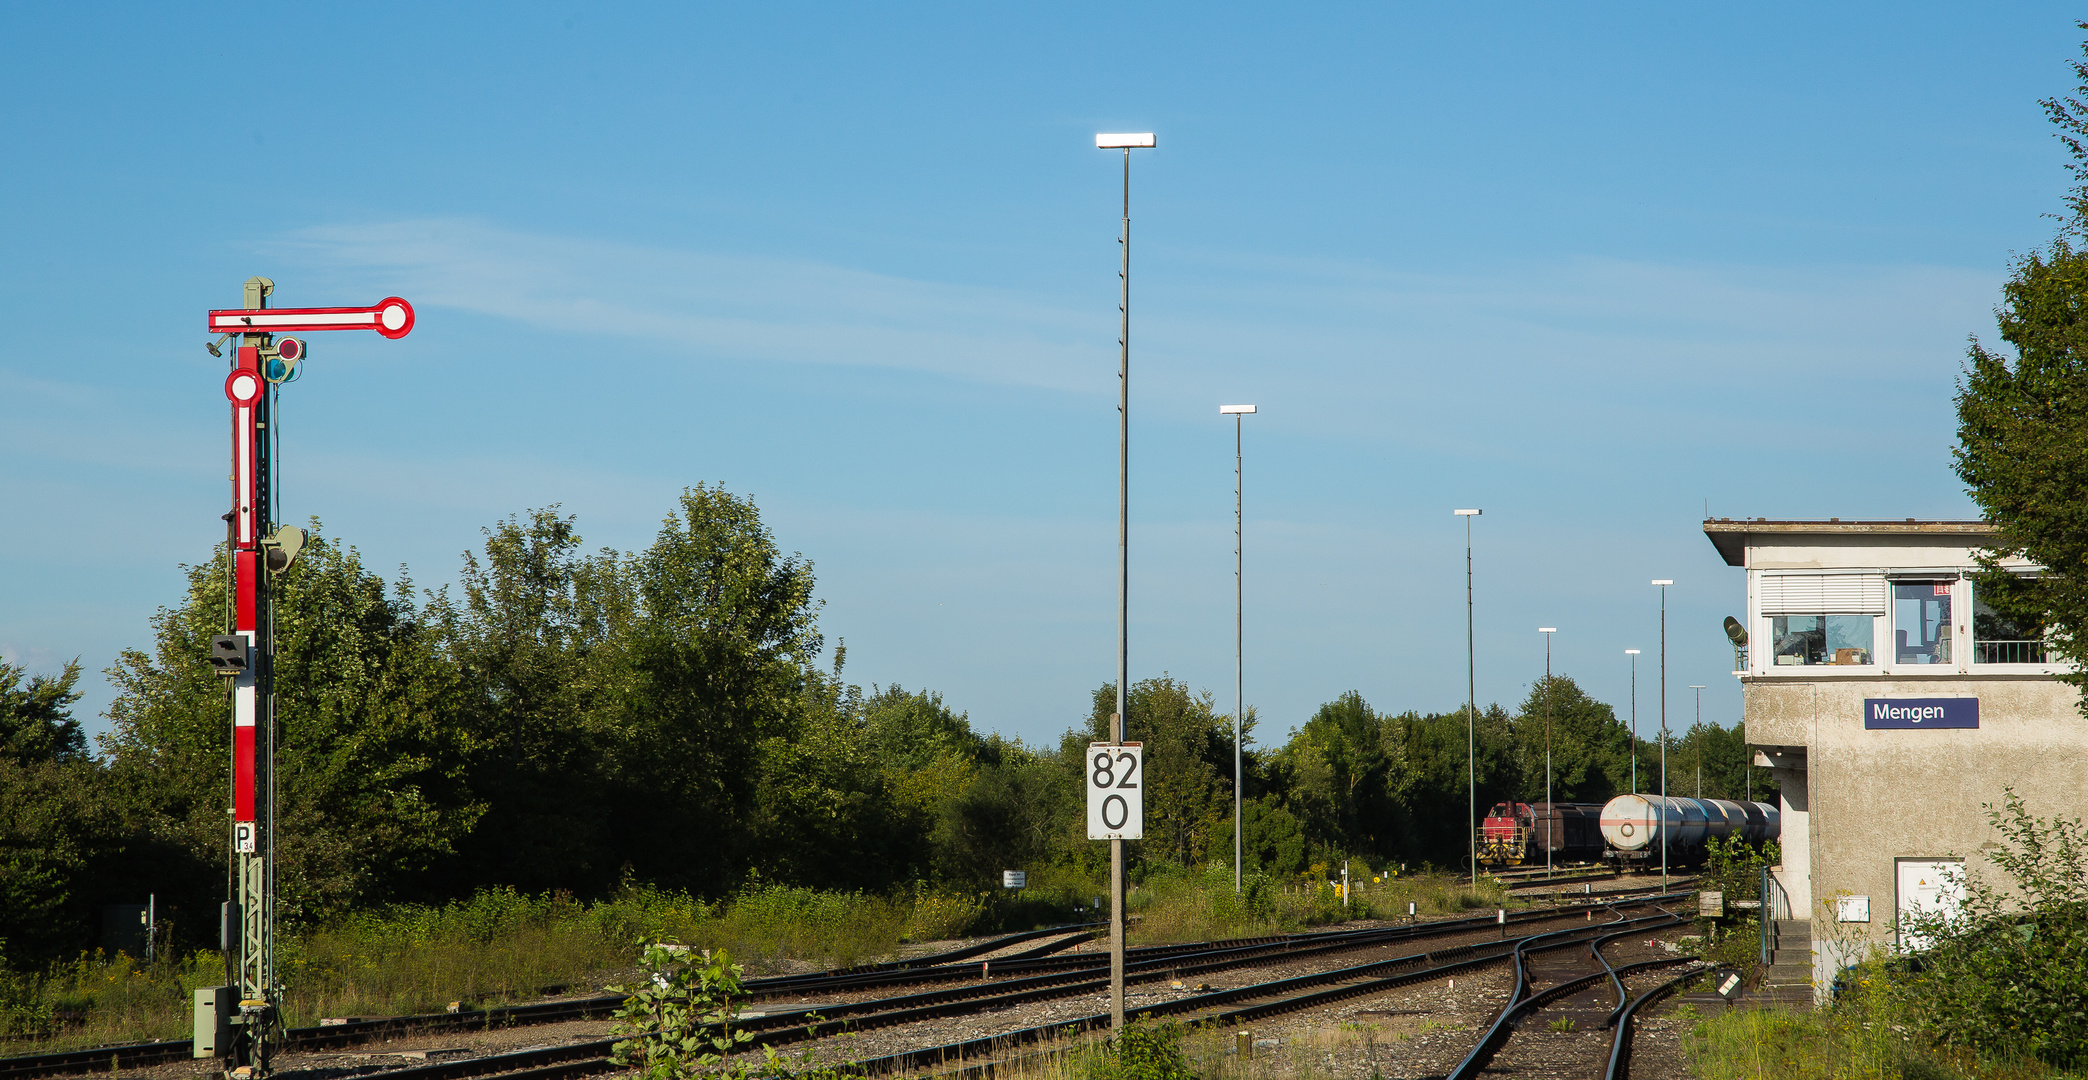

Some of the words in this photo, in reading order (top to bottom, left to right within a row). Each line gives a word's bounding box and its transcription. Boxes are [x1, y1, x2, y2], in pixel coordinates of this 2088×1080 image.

[1873, 703, 1945, 723] Mengen
[1092, 752, 1138, 789] 82
[1101, 794, 1129, 830] 0
[237, 826, 250, 850] P
